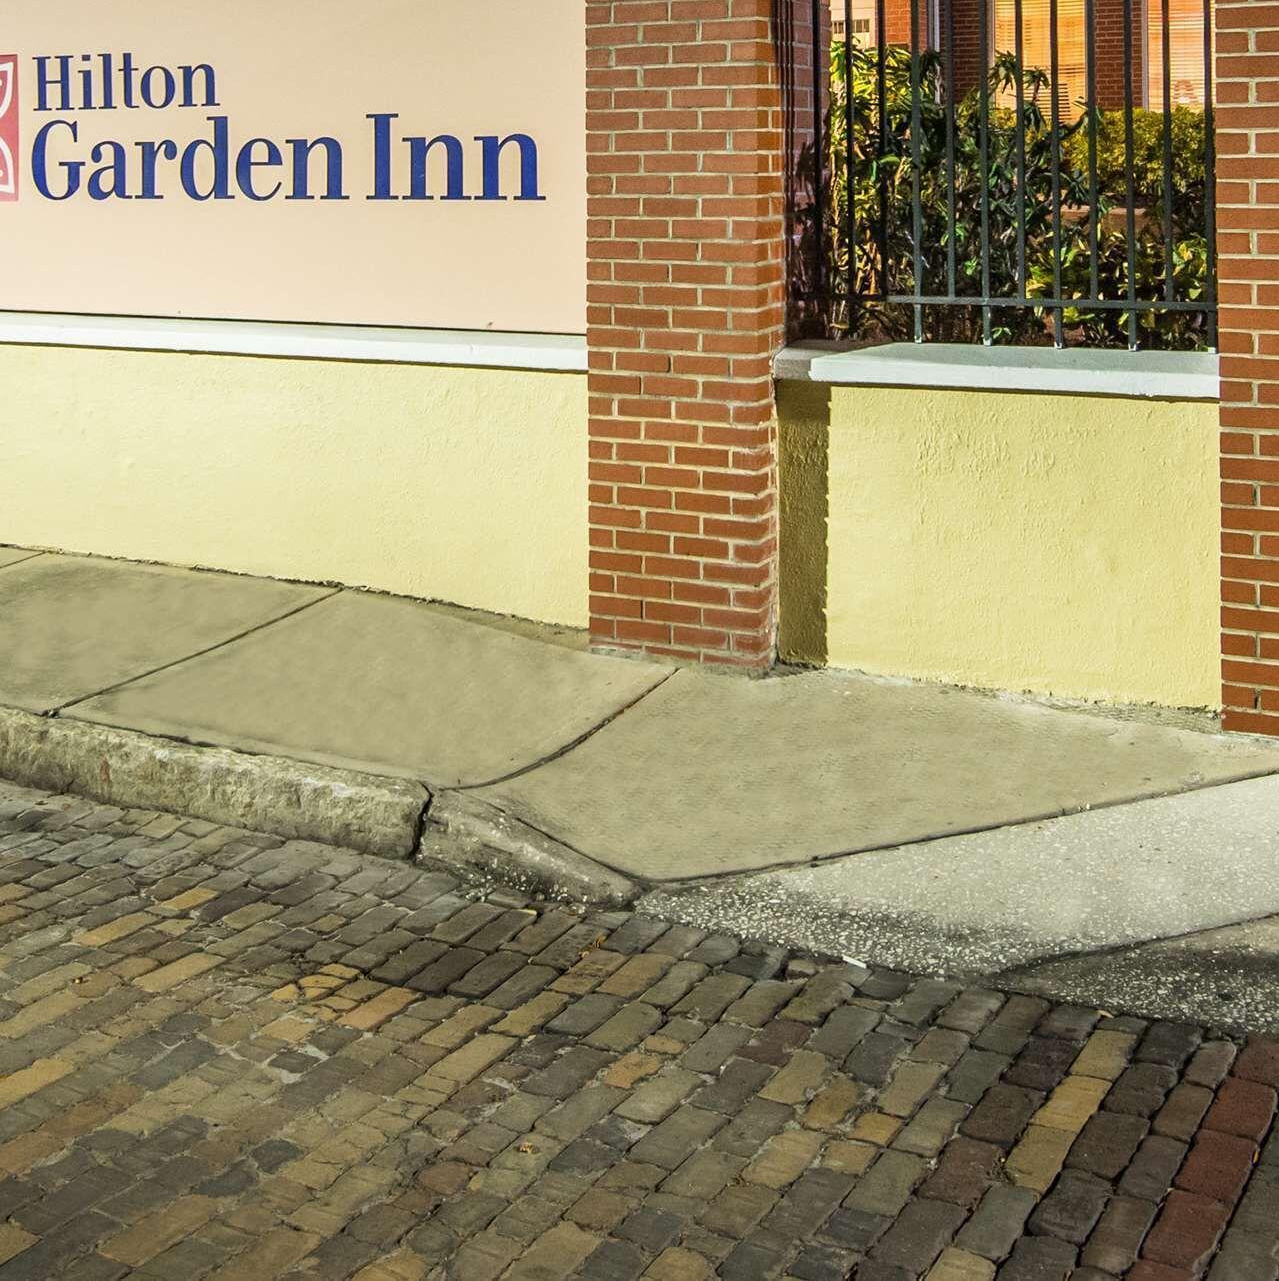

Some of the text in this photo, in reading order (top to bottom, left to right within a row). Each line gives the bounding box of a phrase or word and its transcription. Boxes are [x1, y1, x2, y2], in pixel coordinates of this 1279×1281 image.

[32, 53, 220, 111] Hilton
[31, 113, 546, 201] Garden Inn
